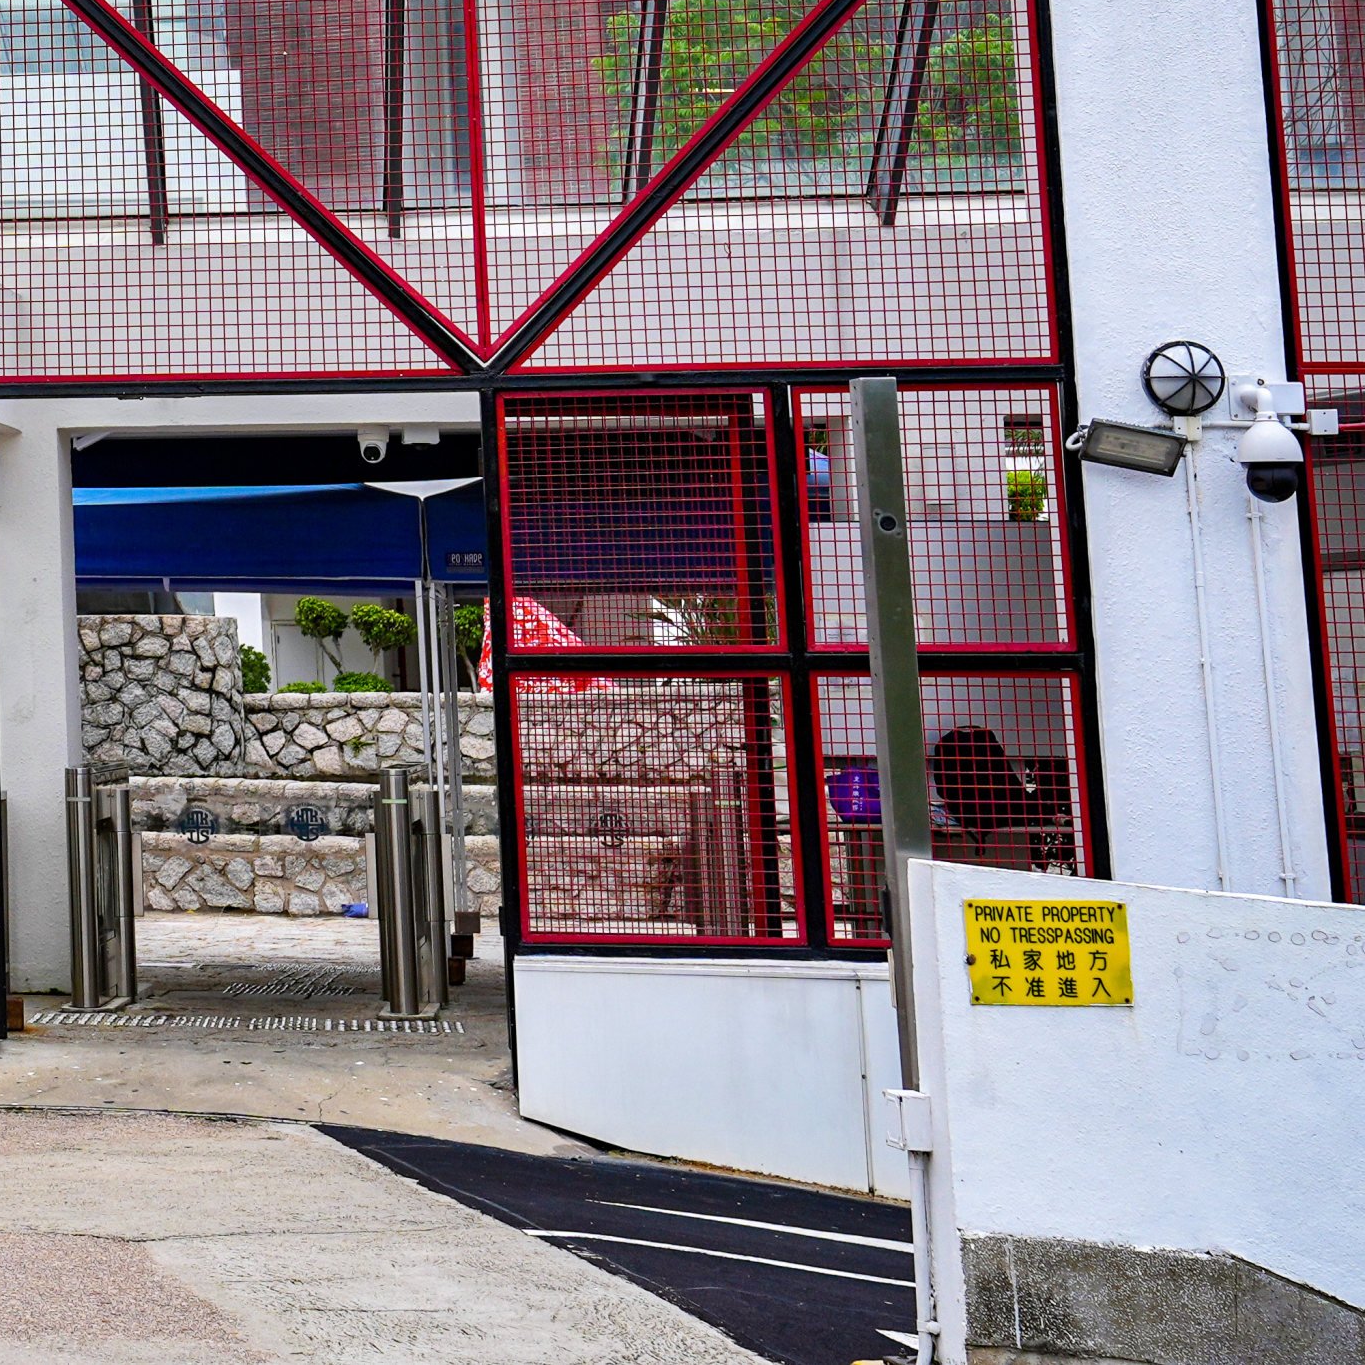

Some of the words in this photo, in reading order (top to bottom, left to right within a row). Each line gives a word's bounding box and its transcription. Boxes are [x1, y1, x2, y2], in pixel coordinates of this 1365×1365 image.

[974, 905, 1034, 923] PRIVATE
[1042, 905, 1115, 923] PROPERTY
[980, 926, 1001, 944] NO
[1009, 927, 1115, 944] TRESSPASSING
[989, 948, 1108, 972] 私家地方
[991, 976, 1112, 999] 不准進入
